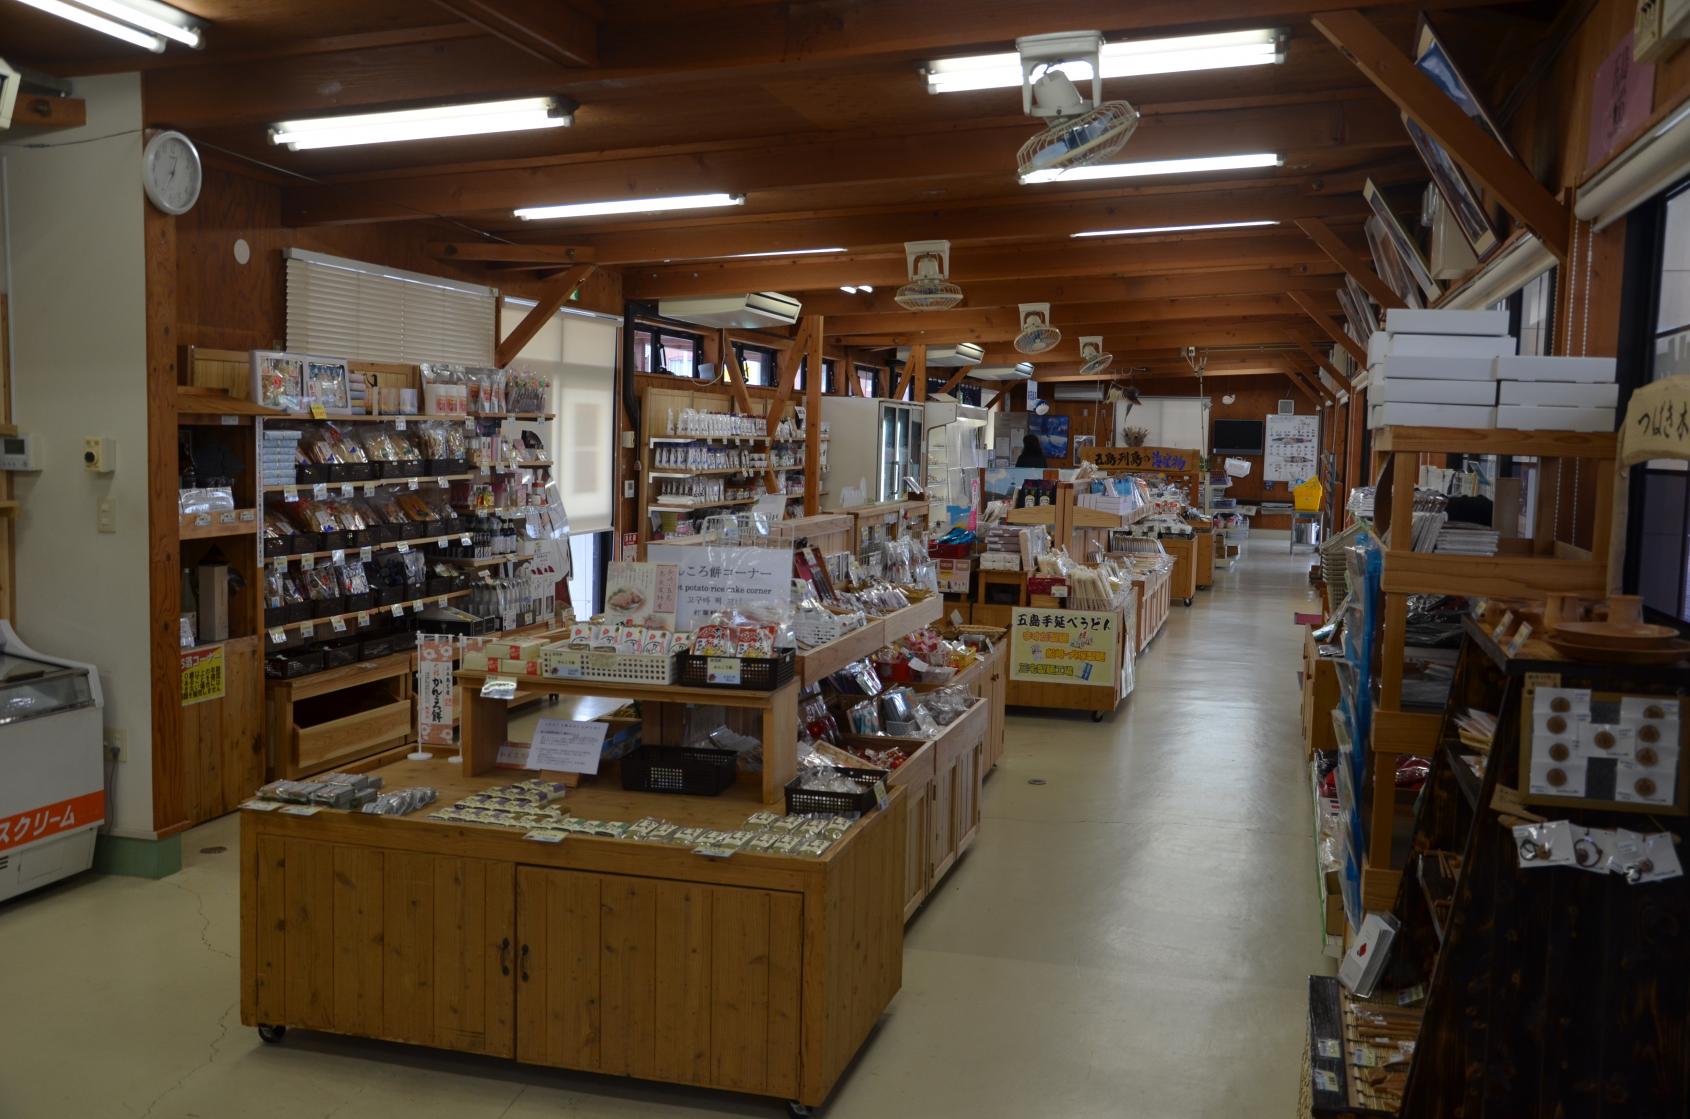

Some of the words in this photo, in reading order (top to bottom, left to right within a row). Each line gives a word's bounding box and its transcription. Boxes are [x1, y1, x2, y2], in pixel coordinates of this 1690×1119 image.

[685, 584, 708, 592] potato
[747, 587, 772, 595] corner
[1017, 614, 1111, 631] 五島手延べうどん
[0, 804, 75, 843] スクリーム
